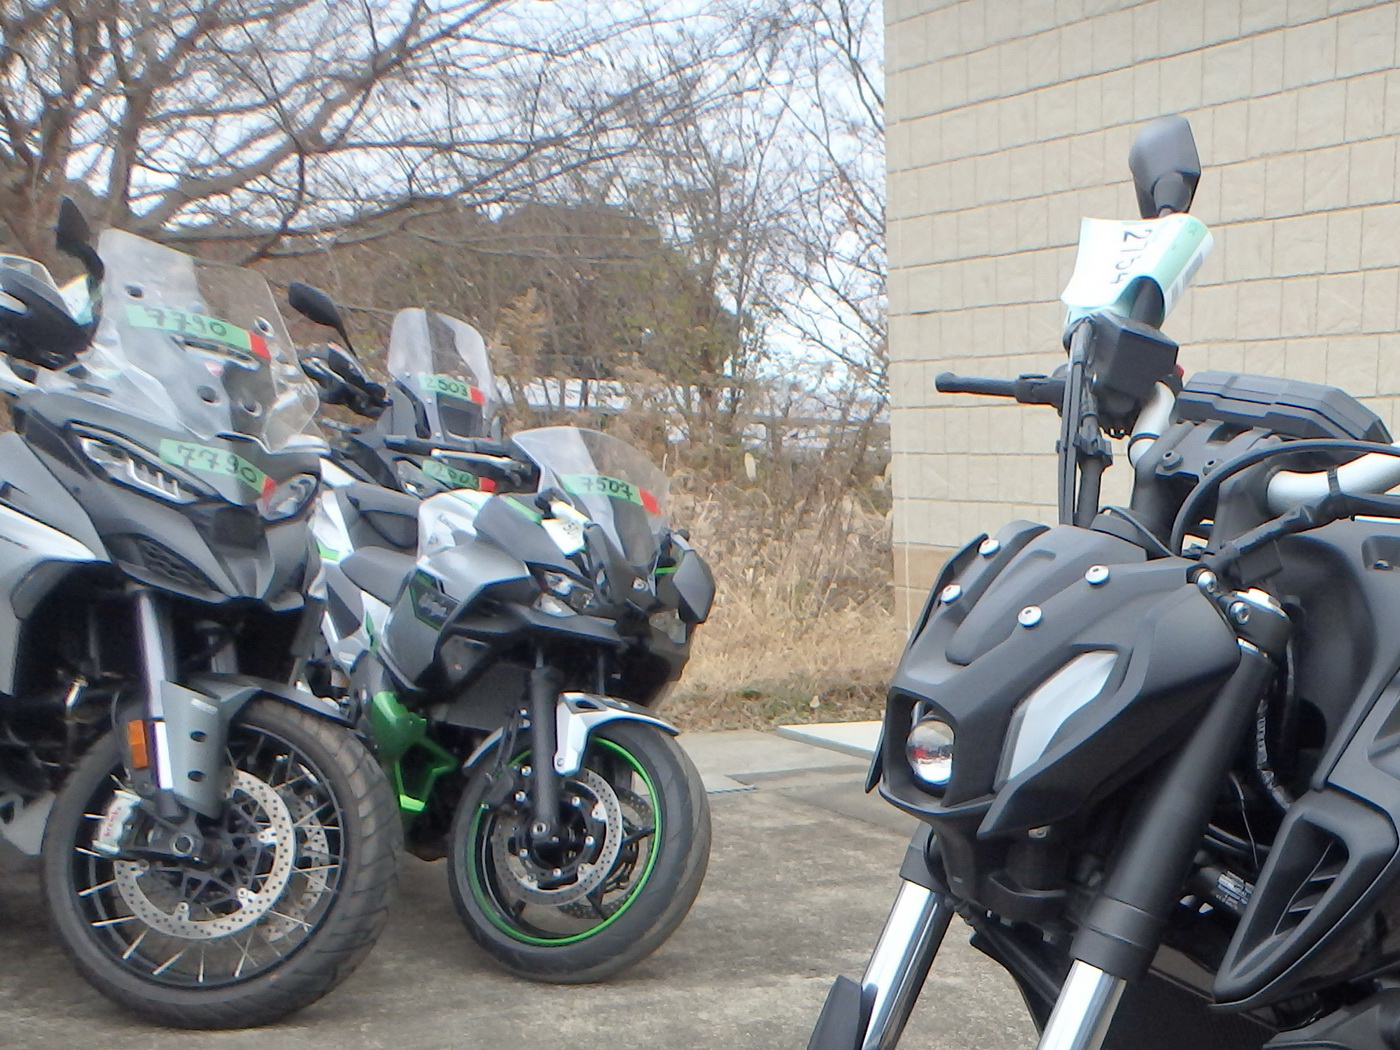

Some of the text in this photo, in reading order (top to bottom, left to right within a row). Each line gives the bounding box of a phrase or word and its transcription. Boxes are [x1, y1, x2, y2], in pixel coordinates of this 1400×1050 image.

[144, 306, 227, 336] 7790
[427, 378, 468, 397] 2503
[177, 445, 258, 483] 7790
[582, 477, 634, 500] 7507
